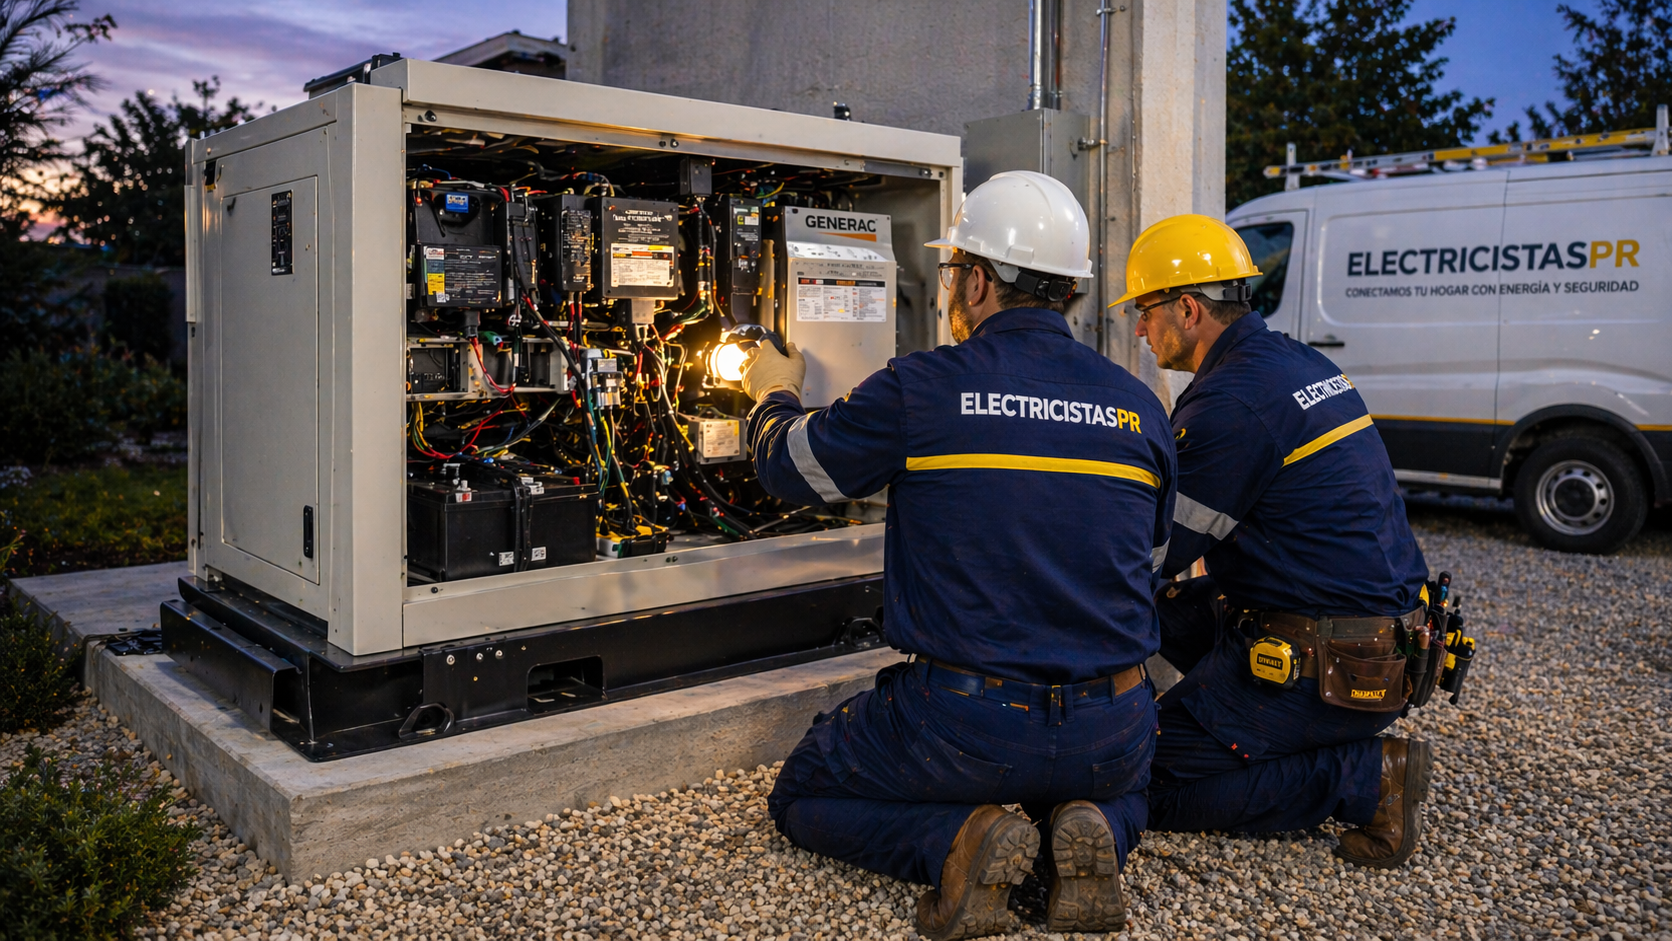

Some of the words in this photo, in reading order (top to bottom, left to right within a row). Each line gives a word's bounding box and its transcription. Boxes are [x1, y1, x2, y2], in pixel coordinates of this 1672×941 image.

[805, 215, 876, 233] GENERAC
[1347, 239, 1640, 277] ELECTRICISTASPR
[1345, 286, 1412, 298] CONECTAMOS
[1414, 286, 1428, 297] TU
[1430, 284, 1469, 297] HOGAR
[1471, 284, 1496, 296] CON
[1499, 280, 1550, 295] ENERGÍA
[1553, 282, 1562, 294] Y
[1564, 280, 1639, 294] SEGURIDAD
[960, 392, 1142, 434] ELECTRICISTASPR
